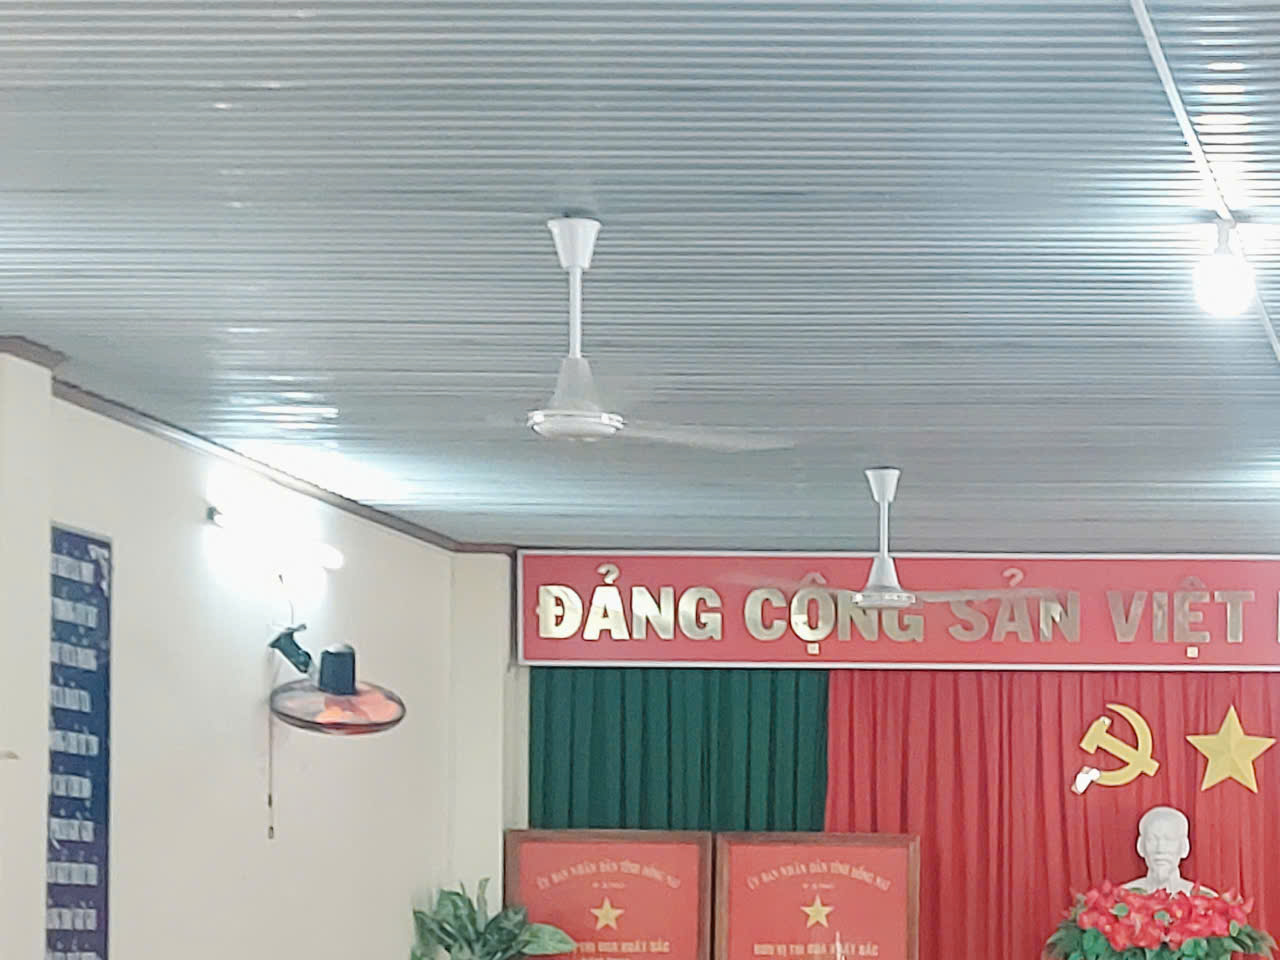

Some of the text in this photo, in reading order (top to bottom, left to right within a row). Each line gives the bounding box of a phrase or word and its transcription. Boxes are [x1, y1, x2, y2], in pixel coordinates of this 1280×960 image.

[536, 563, 722, 641] ĐẢNG
[744, 572, 924, 656] CỘNG
[948, 568, 1080, 643] SẢN
[1106, 576, 1256, 658] VIỆT
